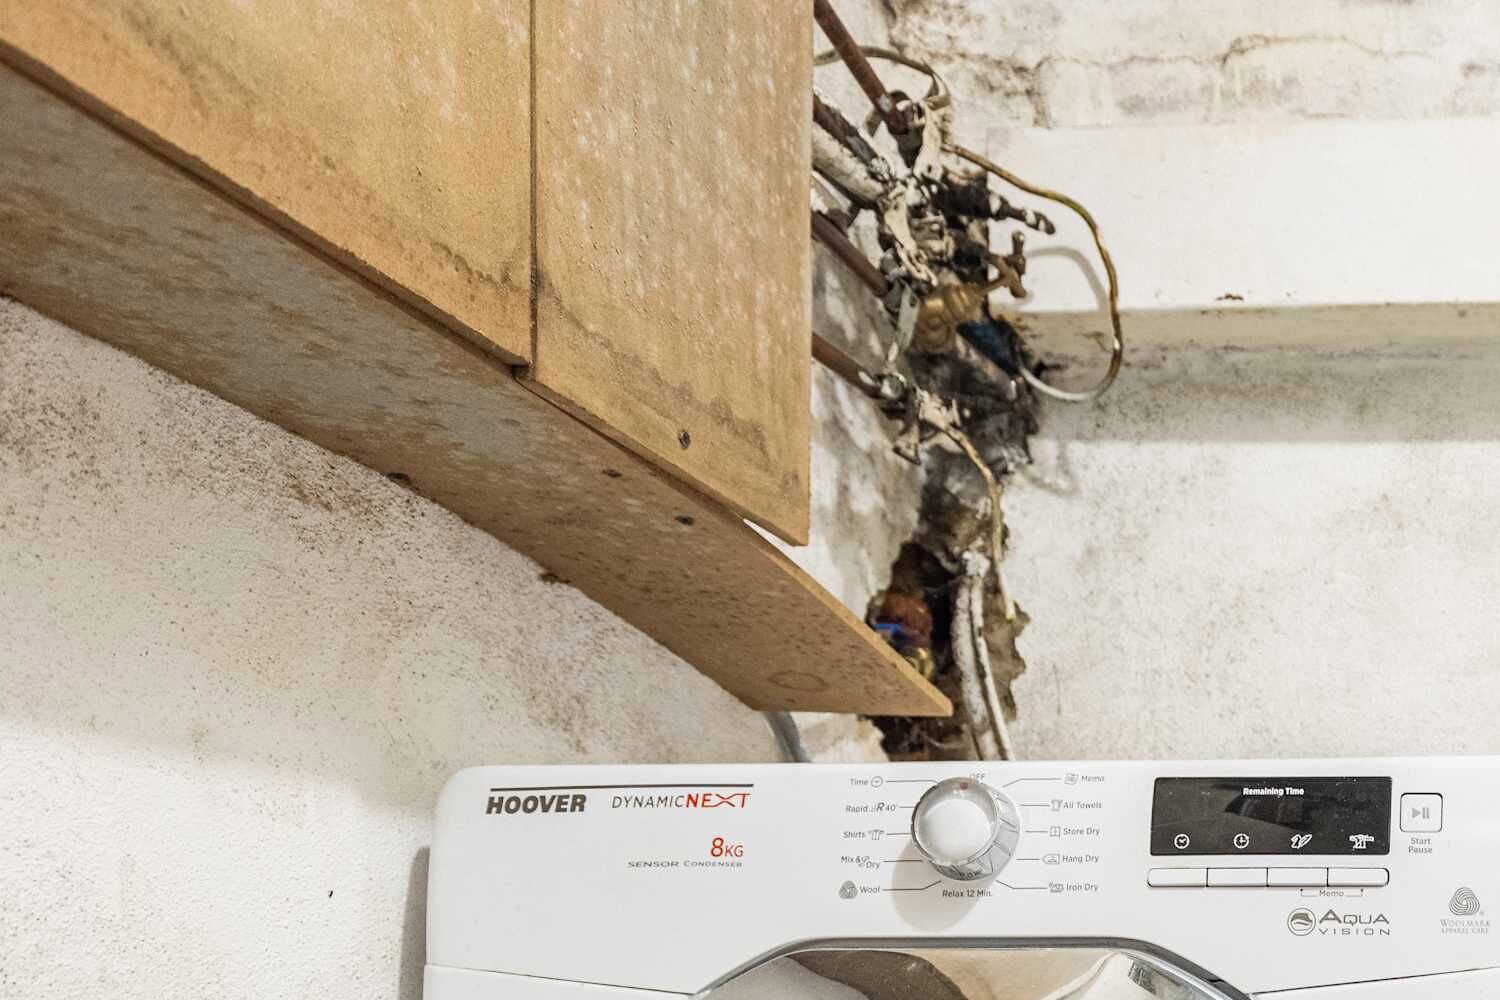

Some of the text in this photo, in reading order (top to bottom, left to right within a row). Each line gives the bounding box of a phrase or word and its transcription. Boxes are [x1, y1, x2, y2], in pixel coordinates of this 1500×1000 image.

[850, 778, 869, 787] Time
[1081, 774, 1104, 783] Memo
[1243, 787, 1304, 798] Remaining Time
[486, 794, 587, 815] HOOVER
[612, 793, 751, 809] DYNAMICNEXT
[1063, 801, 1102, 810] All Towels
[846, 805, 868, 814] Rapid
[843, 830, 866, 839] Shirts
[1063, 828, 1101, 837] Store Dry
[1410, 837, 1431, 846] Start
[1408, 846, 1432, 855] Pause
[841, 855, 854, 864] Mix
[1063, 854, 1100, 864] Hang Dry
[628, 860, 679, 869] SENSOR
[866, 860, 880, 870] Dry
[860, 885, 881, 894] Wool
[1066, 883, 1099, 892] Iron Dry
[942, 889, 964, 898] Relax
[966, 889, 975, 897] 12
[1319, 889, 1344, 898] Memo
[1318, 928, 1390, 936] VISION
